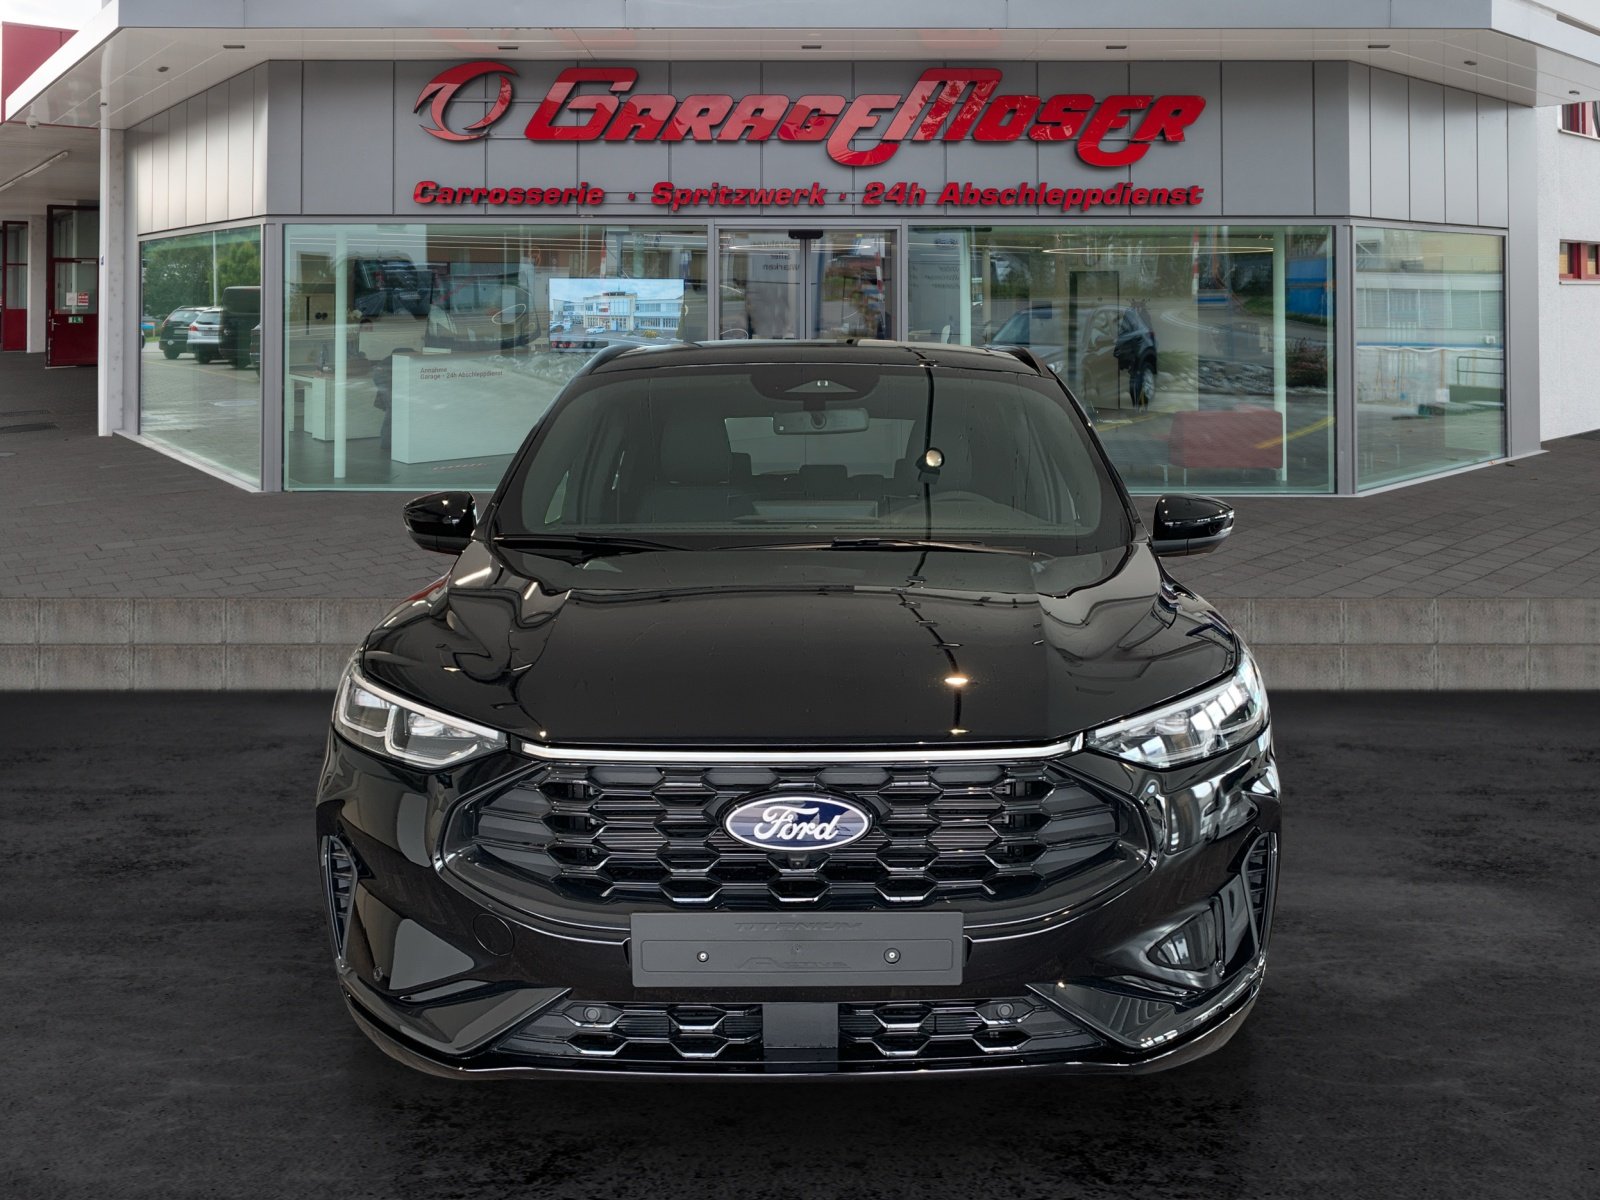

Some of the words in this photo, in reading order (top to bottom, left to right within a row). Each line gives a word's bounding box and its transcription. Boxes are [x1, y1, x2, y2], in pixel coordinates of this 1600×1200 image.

[413, 181, 605, 206] Carrosserie
[651, 182, 827, 211] Spritzwerk
[862, 182, 927, 206] 24h
[937, 182, 1204, 211] Abschleppdienst
[753, 805, 840, 841] Ford
